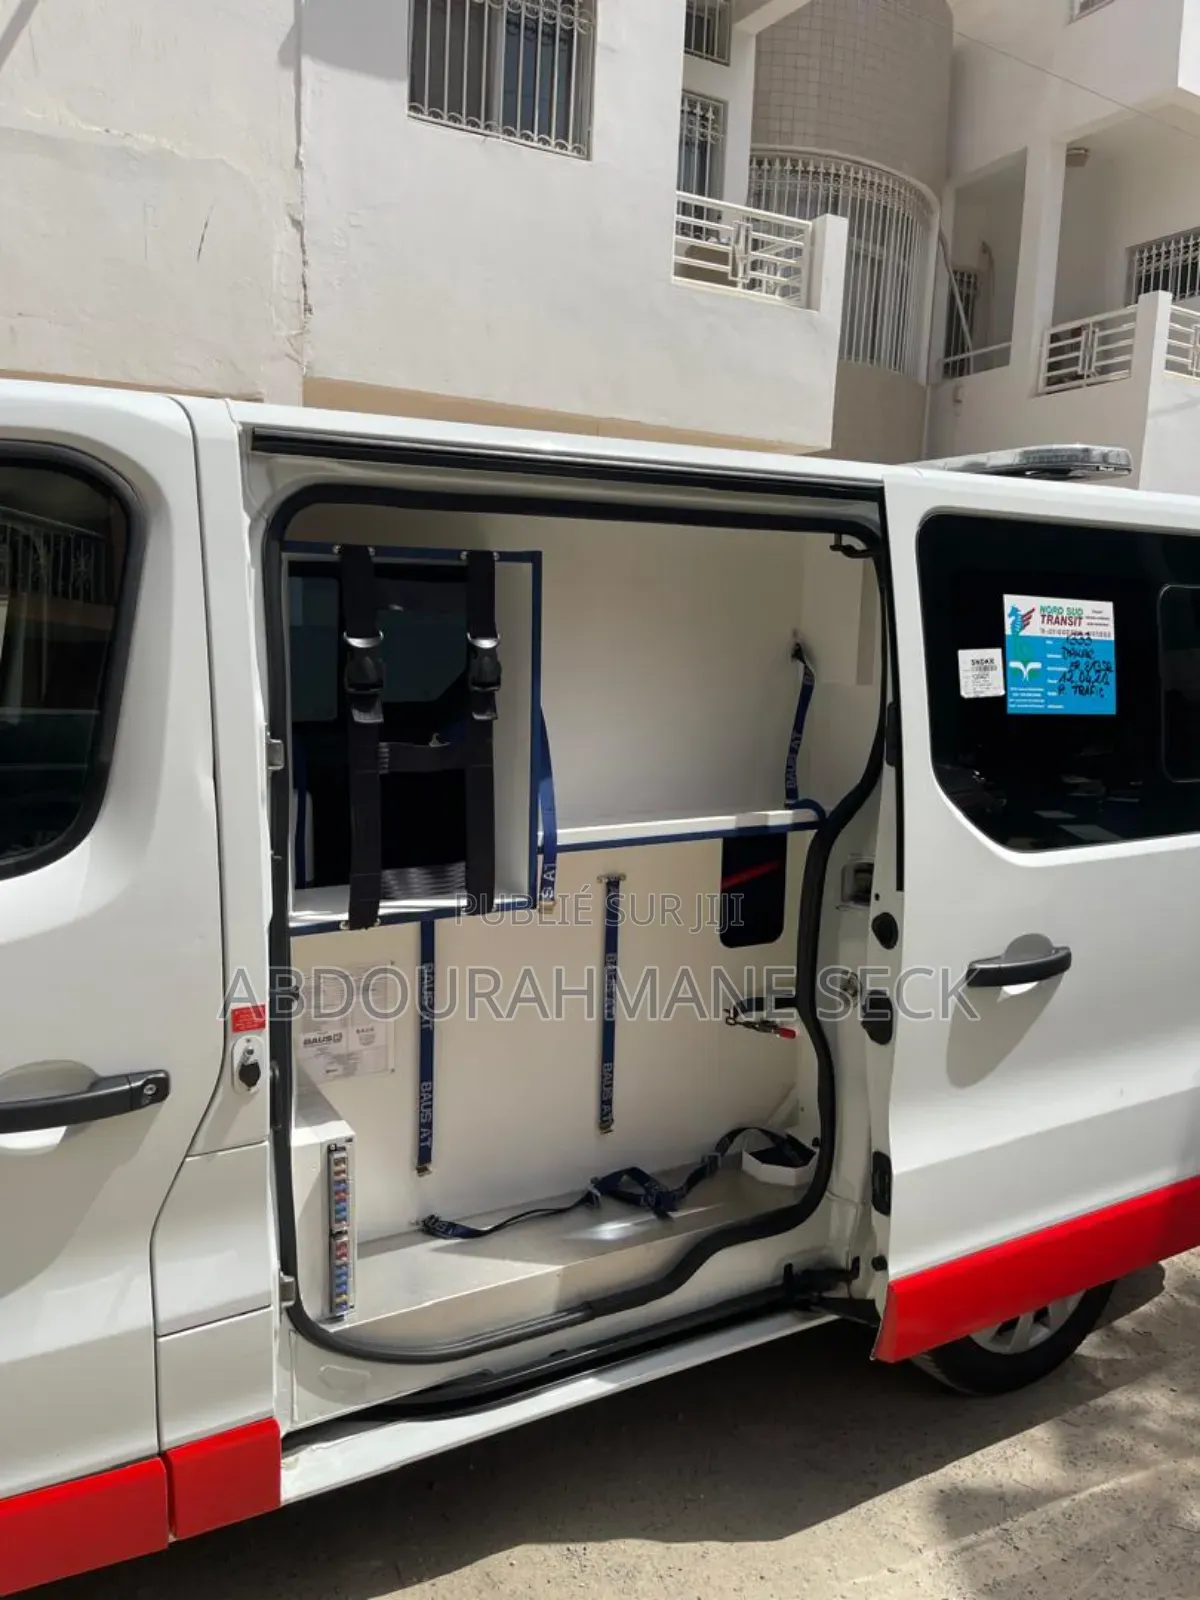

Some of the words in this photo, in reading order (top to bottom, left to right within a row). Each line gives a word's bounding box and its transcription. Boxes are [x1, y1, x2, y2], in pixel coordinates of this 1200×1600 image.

[1039, 605, 1064, 615] NORD
[1066, 606, 1084, 616] SUD
[1040, 614, 1083, 627] TRANSIT
[602, 1062, 613, 1100] BAUS
[420, 1081, 432, 1123] BAUS
[420, 1127, 431, 1148] AT
